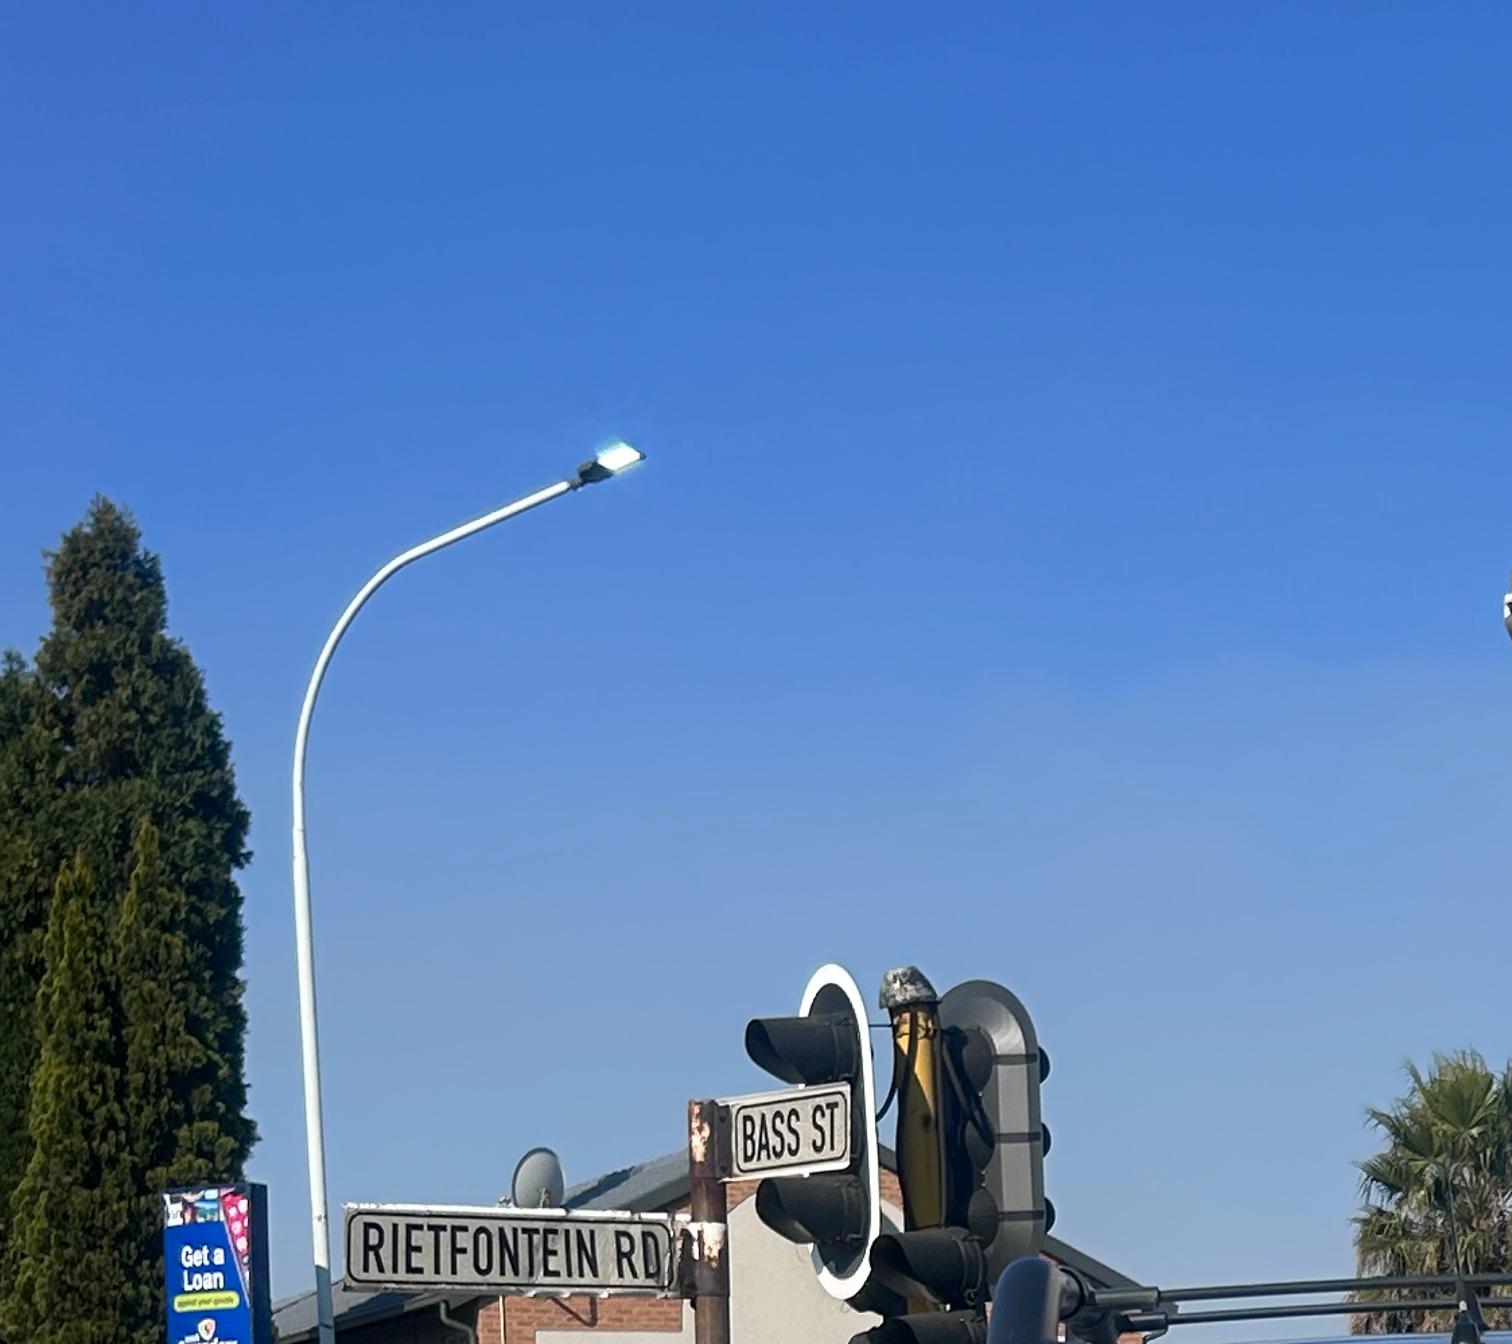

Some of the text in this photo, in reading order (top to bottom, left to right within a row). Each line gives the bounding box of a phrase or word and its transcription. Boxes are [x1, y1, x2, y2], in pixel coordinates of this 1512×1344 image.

[743, 1102, 839, 1163] BASS ST
[181, 1245, 225, 1268] Get a
[362, 1222, 661, 1279] RIETFONTEIN RD
[183, 1270, 224, 1291] Loan
